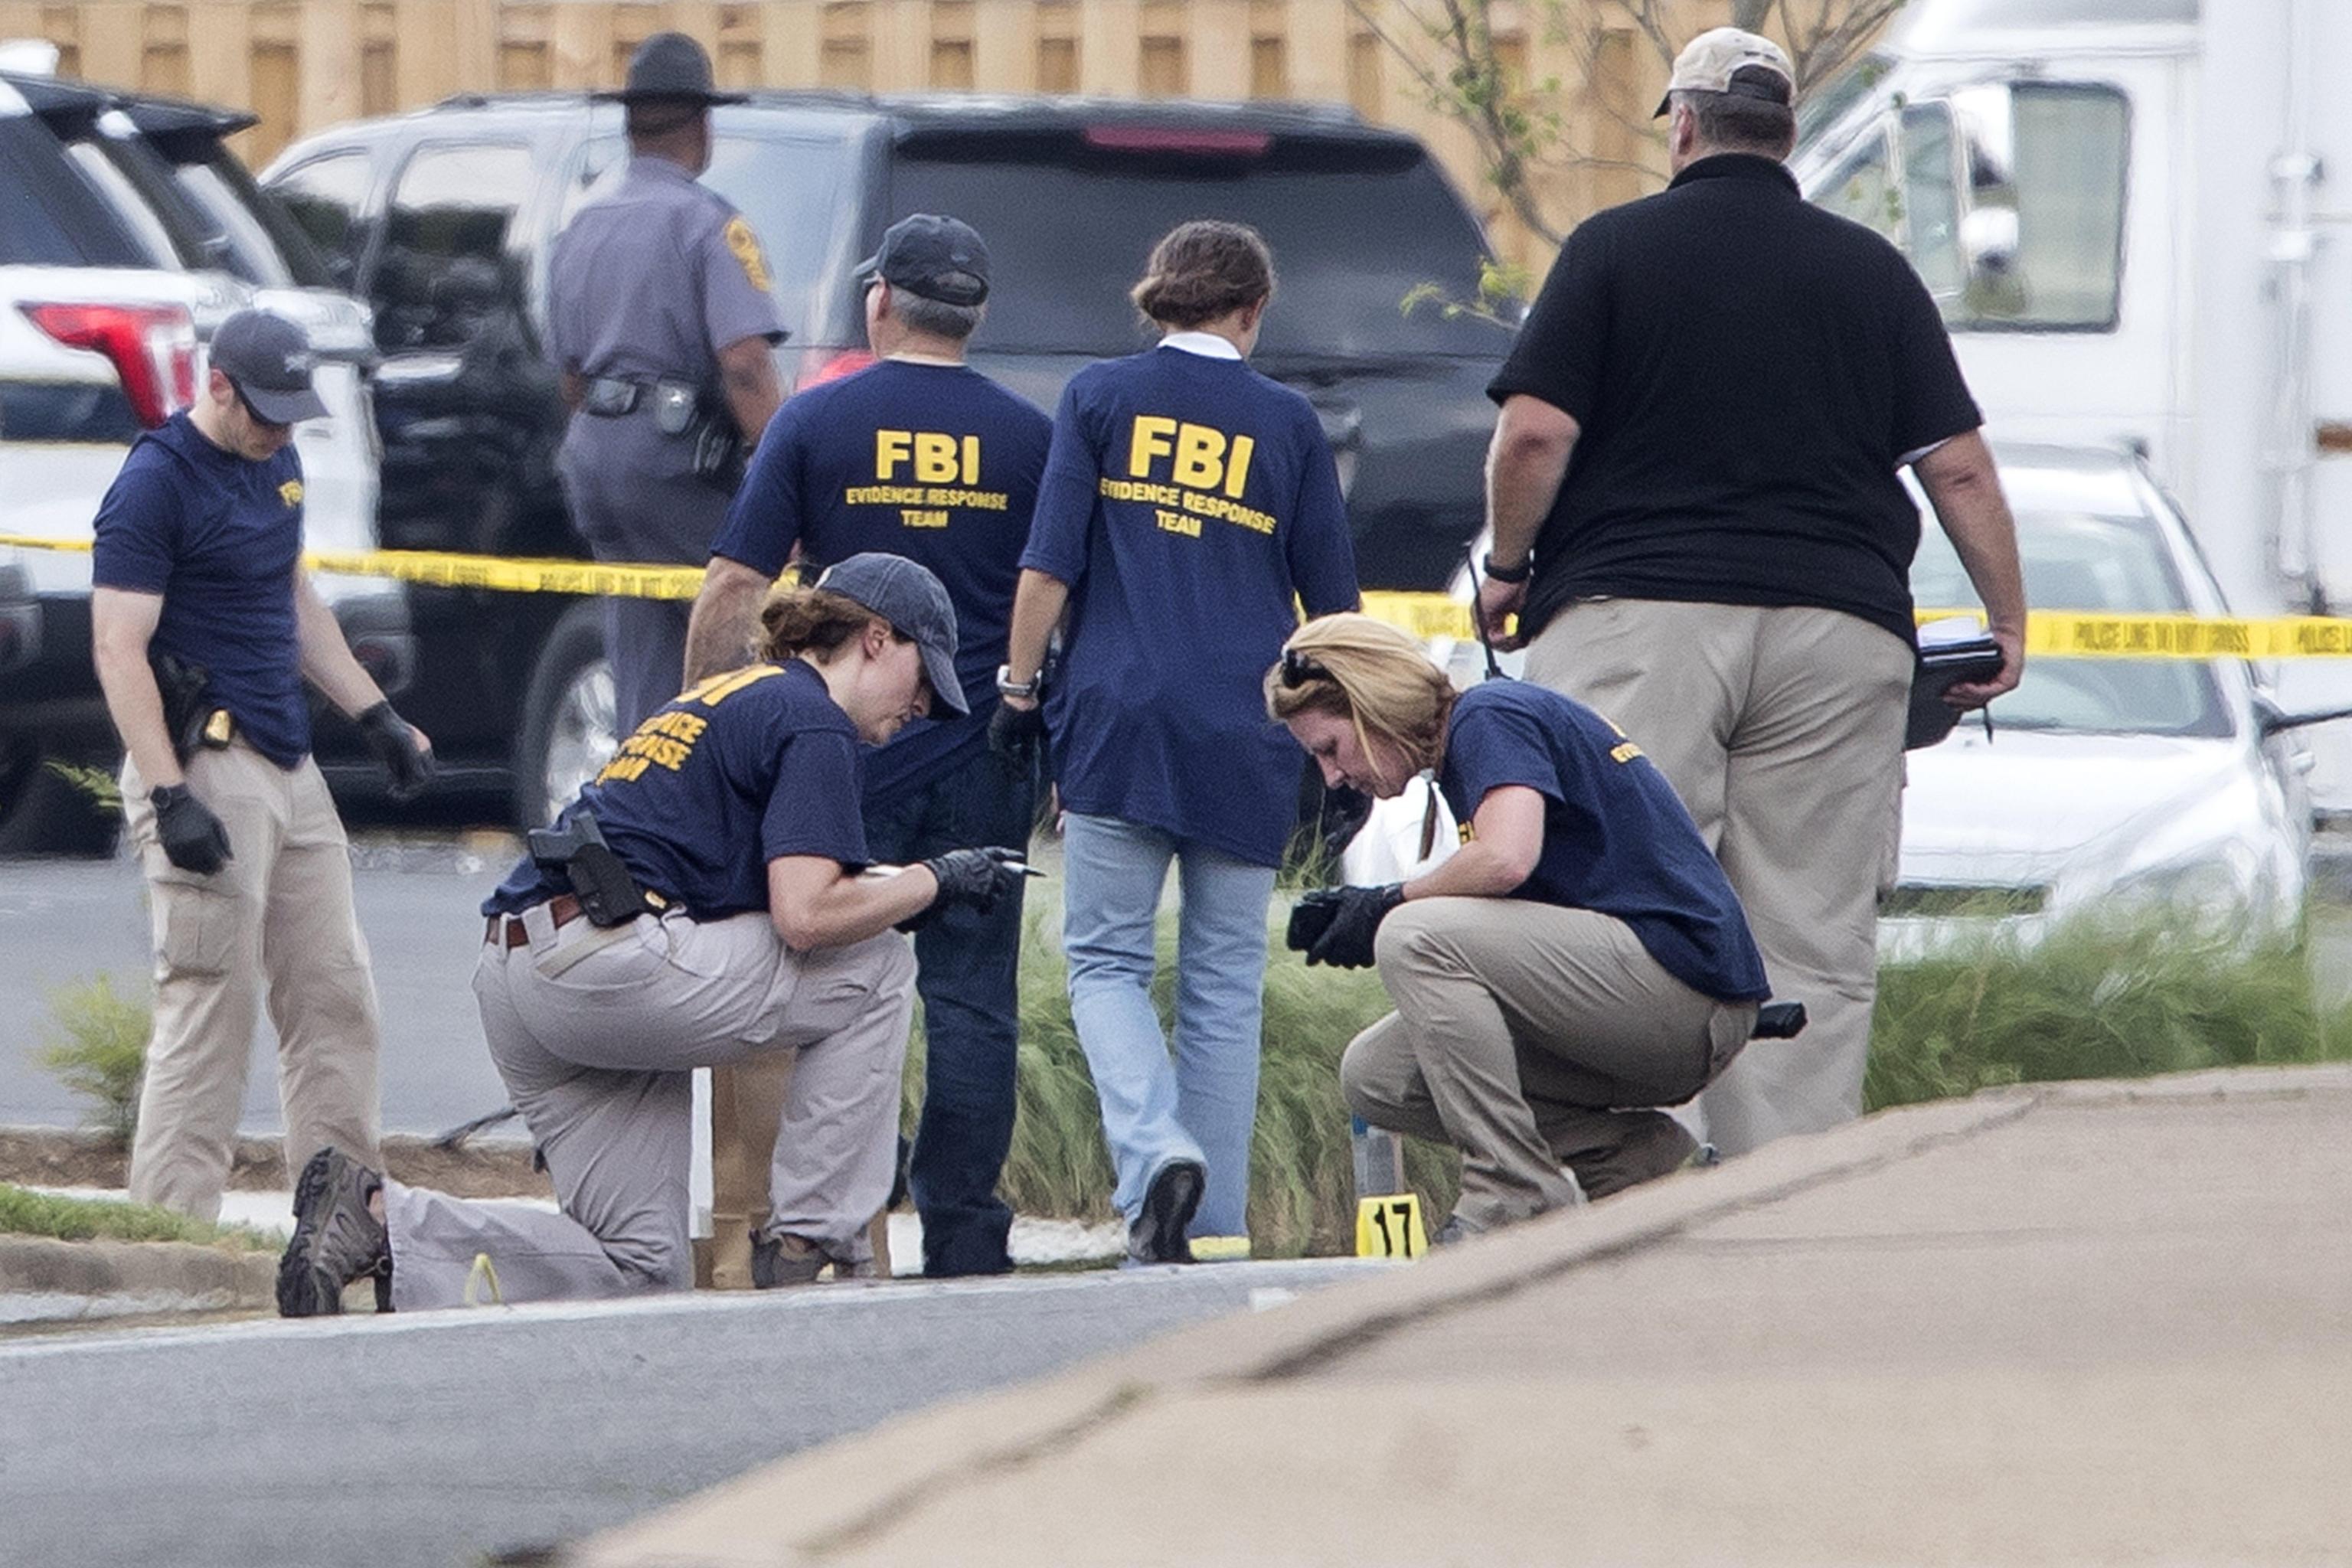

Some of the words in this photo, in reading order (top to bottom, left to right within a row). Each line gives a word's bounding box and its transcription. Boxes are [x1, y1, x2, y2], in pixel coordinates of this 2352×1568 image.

[877, 430, 979, 485] FBI
[1129, 415, 1254, 498] FBI
[846, 486, 924, 505] EVIDENCE
[926, 488, 1008, 511] RESPONSE
[900, 510, 949, 527] TEAM
[1100, 478, 1181, 506] EVIDENCE
[1183, 492, 1276, 534] RESPONSE
[1155, 509, 1202, 537] TEAM
[1374, 1203, 1412, 1259] 17
